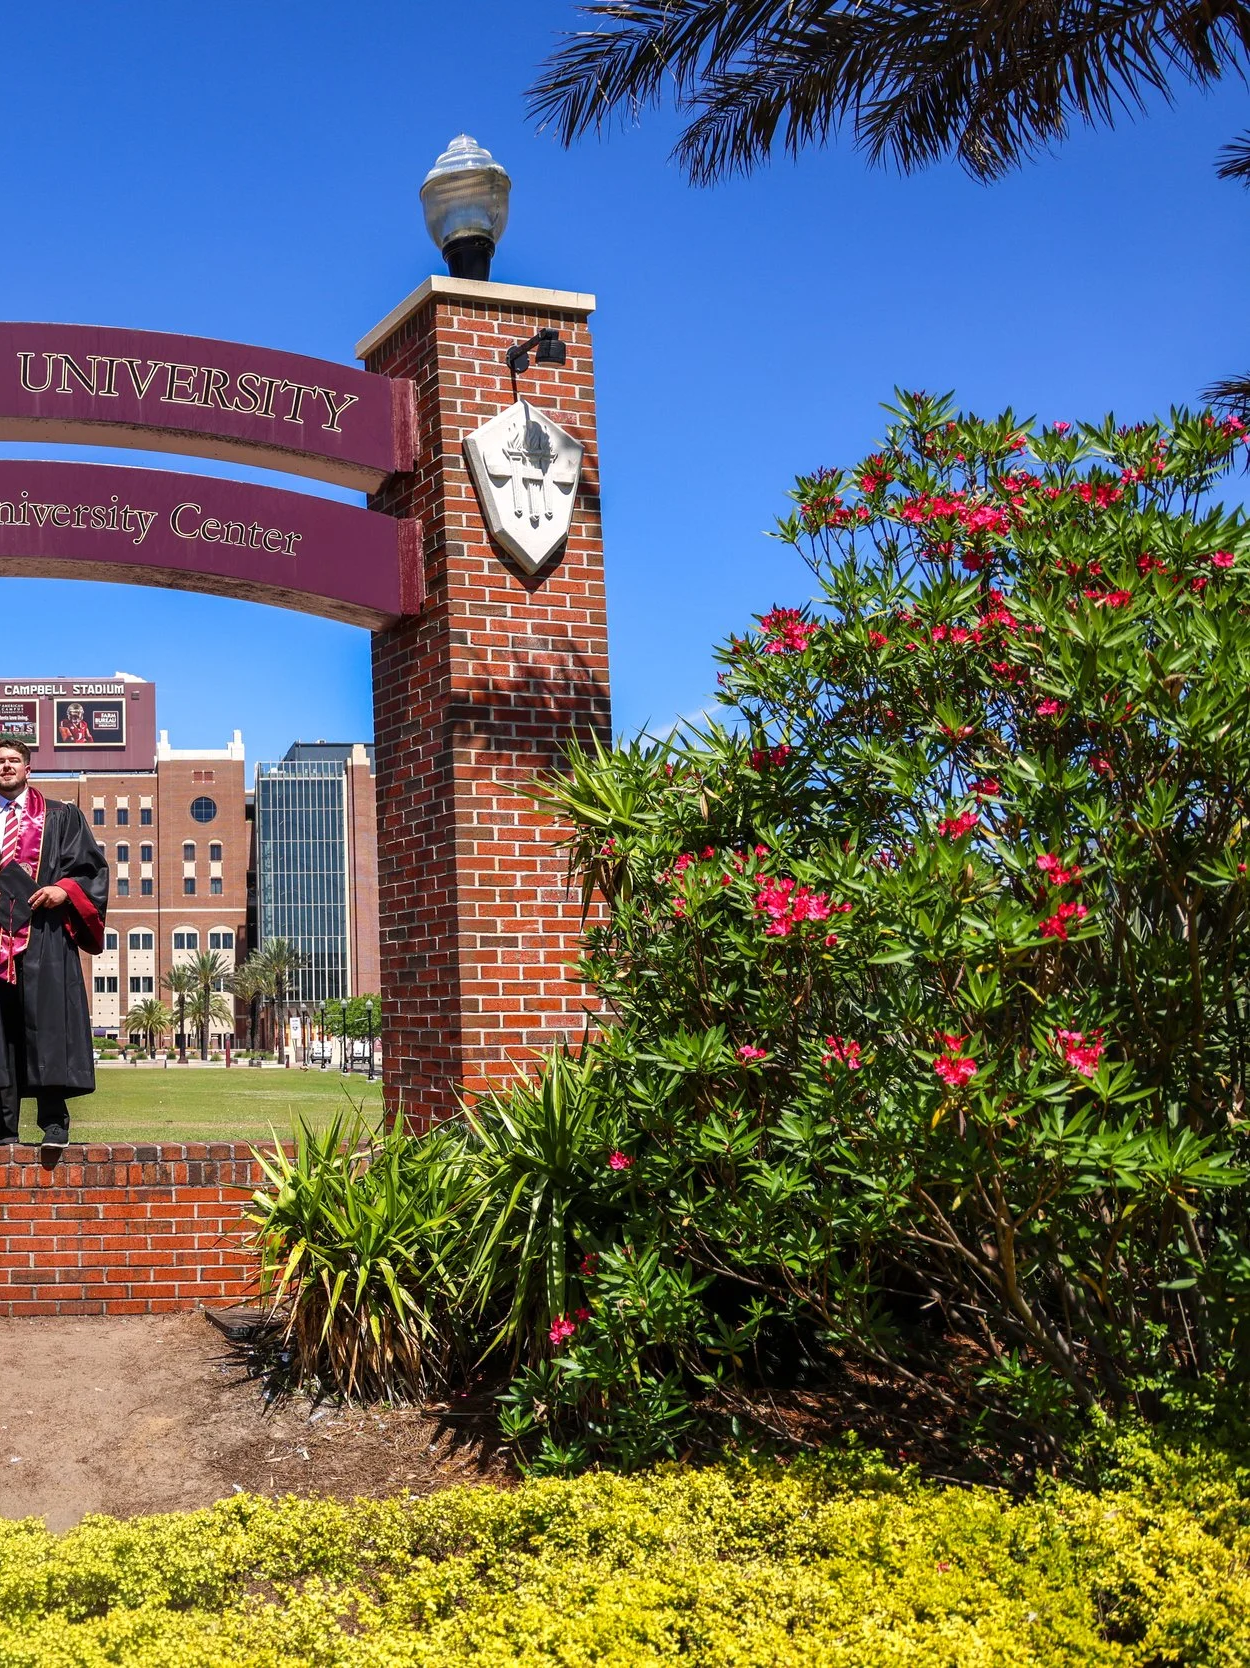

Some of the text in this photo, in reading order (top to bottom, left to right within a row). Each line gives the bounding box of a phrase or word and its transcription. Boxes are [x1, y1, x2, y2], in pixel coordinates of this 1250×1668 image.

[16, 352, 359, 433] UNIVERSITY
[169, 502, 303, 557] Center
[4, 685, 67, 695] CAMPBELL
[72, 684, 125, 695] STADIUM
